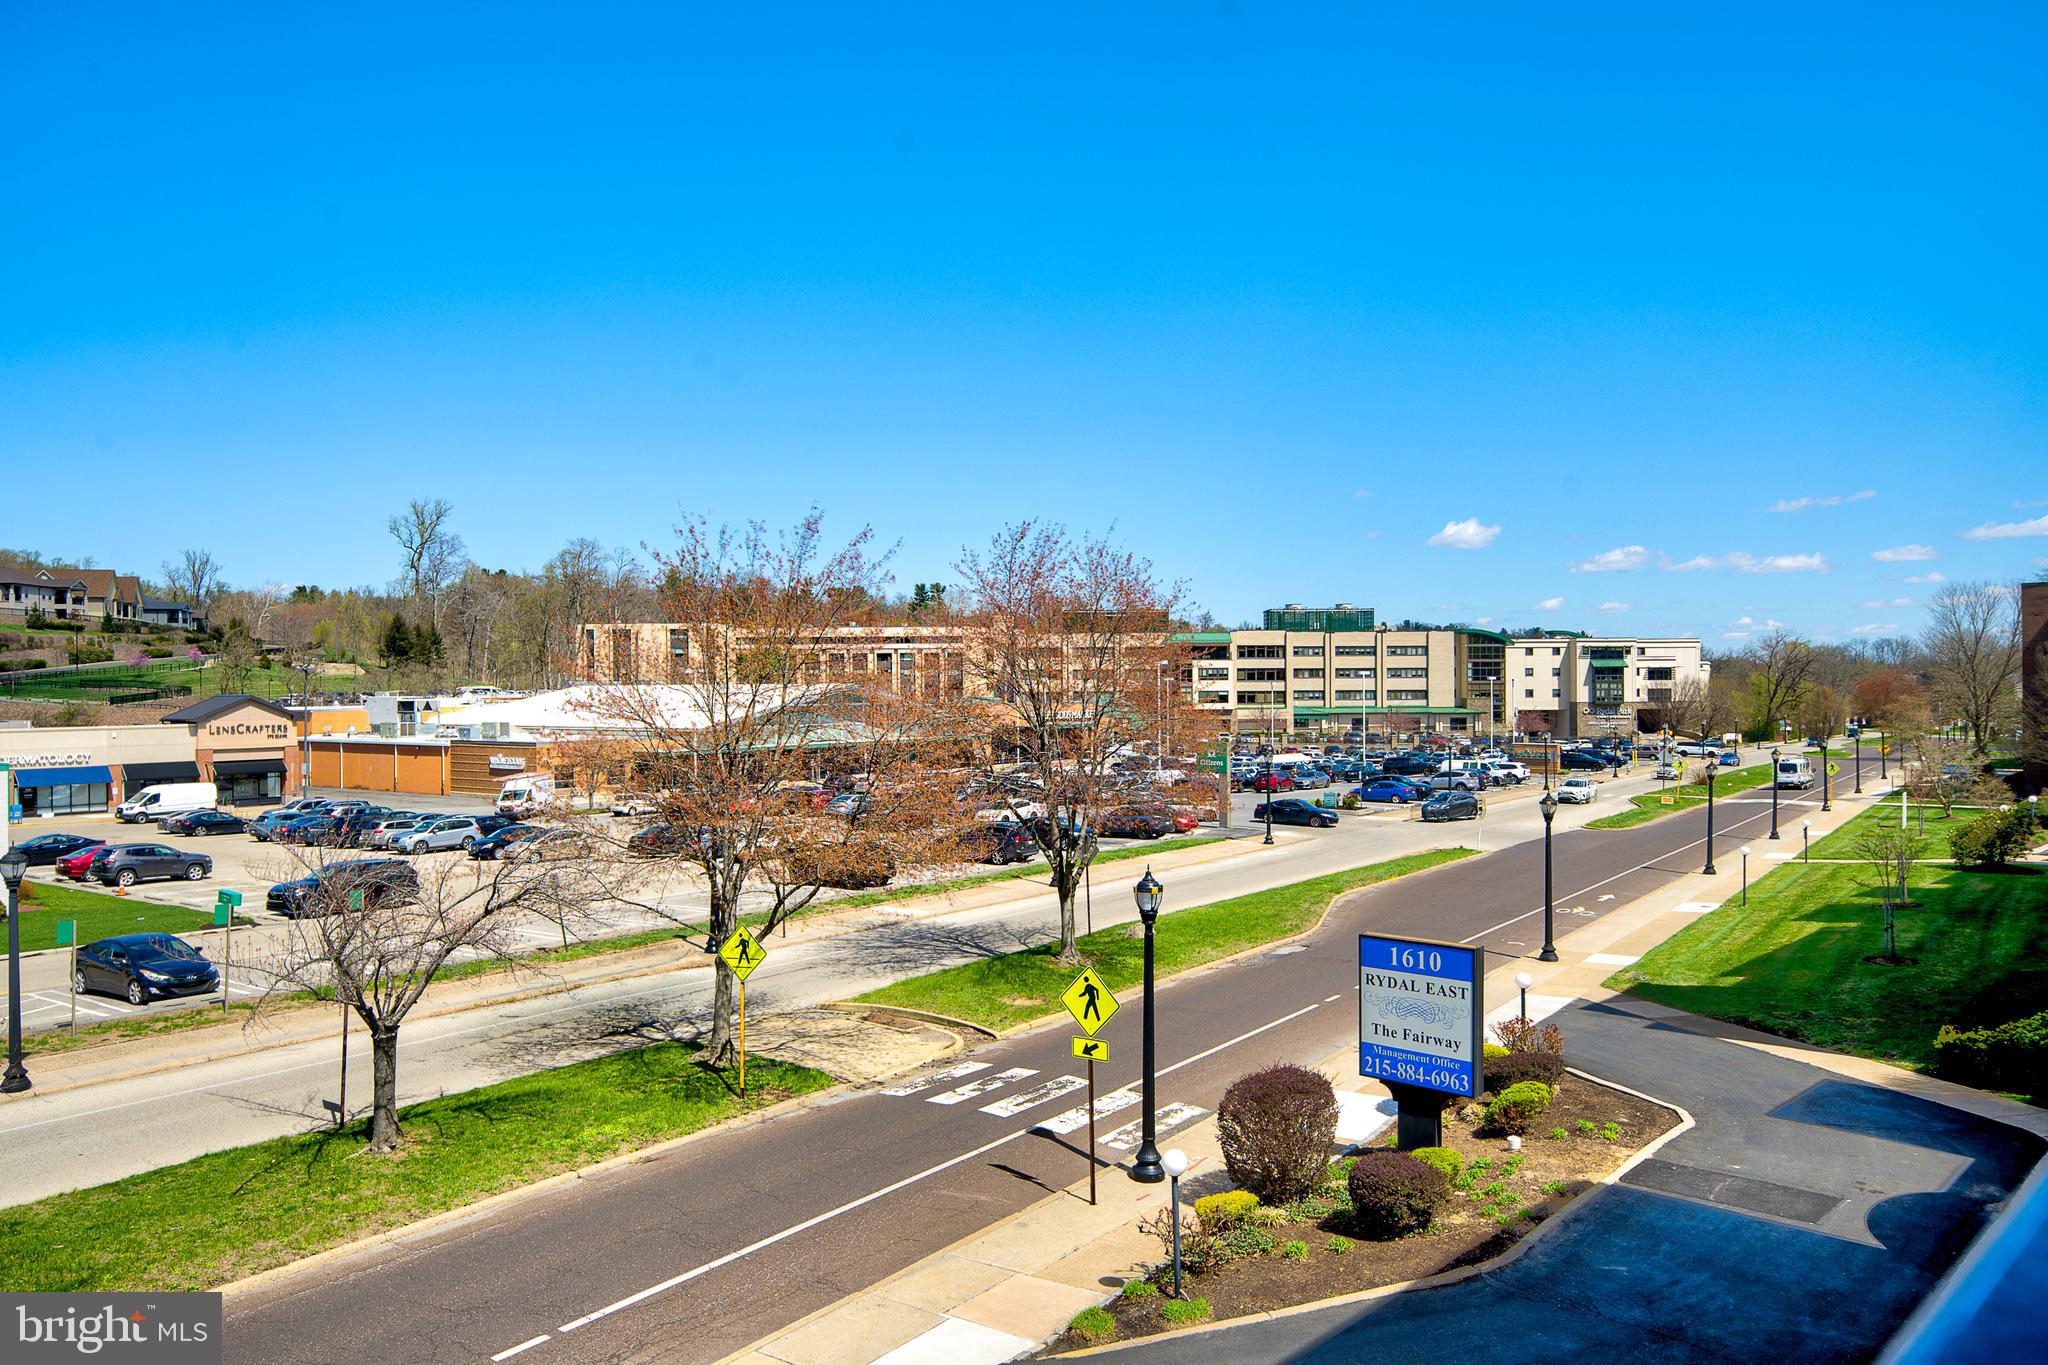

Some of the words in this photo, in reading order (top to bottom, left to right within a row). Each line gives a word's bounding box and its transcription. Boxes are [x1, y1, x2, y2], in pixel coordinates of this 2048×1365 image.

[1390, 946, 1442, 973] 1610
[1365, 972, 1421, 993] RYDAL
[1426, 981, 1469, 1000] EAST
[1371, 1022, 1398, 1039] The
[1402, 1027, 1462, 1053] Fairway
[1372, 1045, 1430, 1064] Management
[1432, 1055, 1461, 1070] Office
[1364, 1055, 1469, 1092] 215-884-6963
